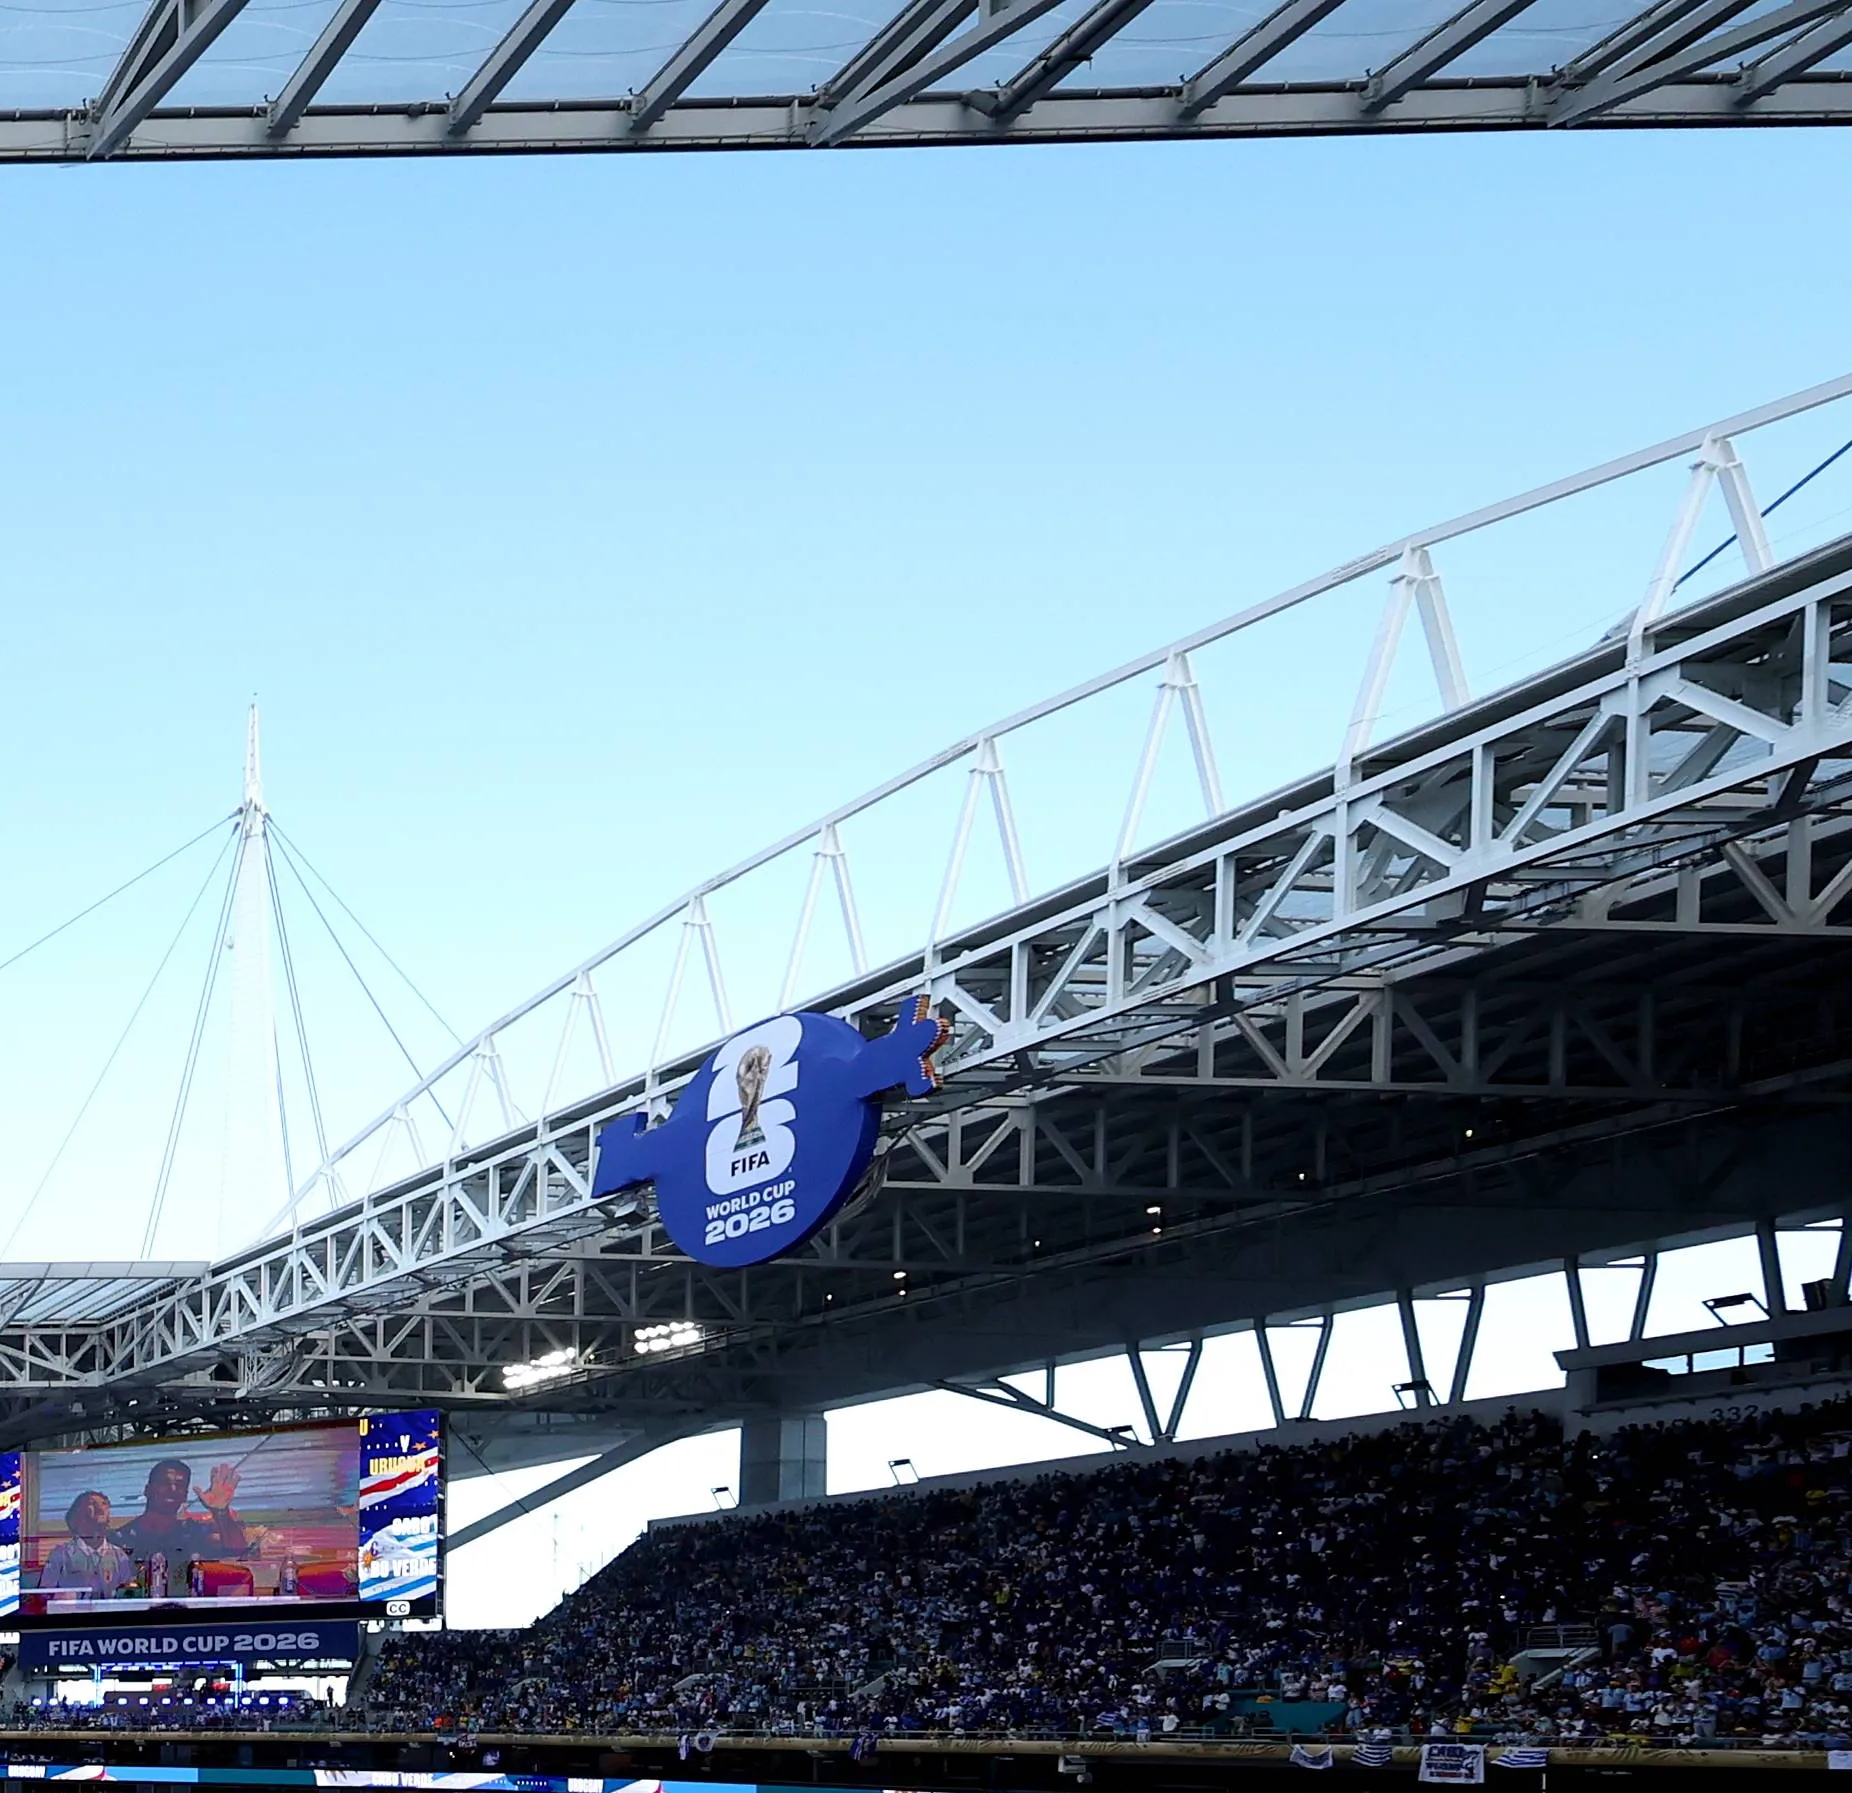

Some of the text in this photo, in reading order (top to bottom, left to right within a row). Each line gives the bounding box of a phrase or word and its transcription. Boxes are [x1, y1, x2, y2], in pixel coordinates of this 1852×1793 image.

[731, 1151, 770, 1177] FIFA
[706, 1180, 795, 1220] WORLD CUP
[705, 1198, 795, 1245] 2026
[389, 1602, 407, 1613] CC
[49, 1632, 320, 1657] FIFA WORLD CUP 2026
